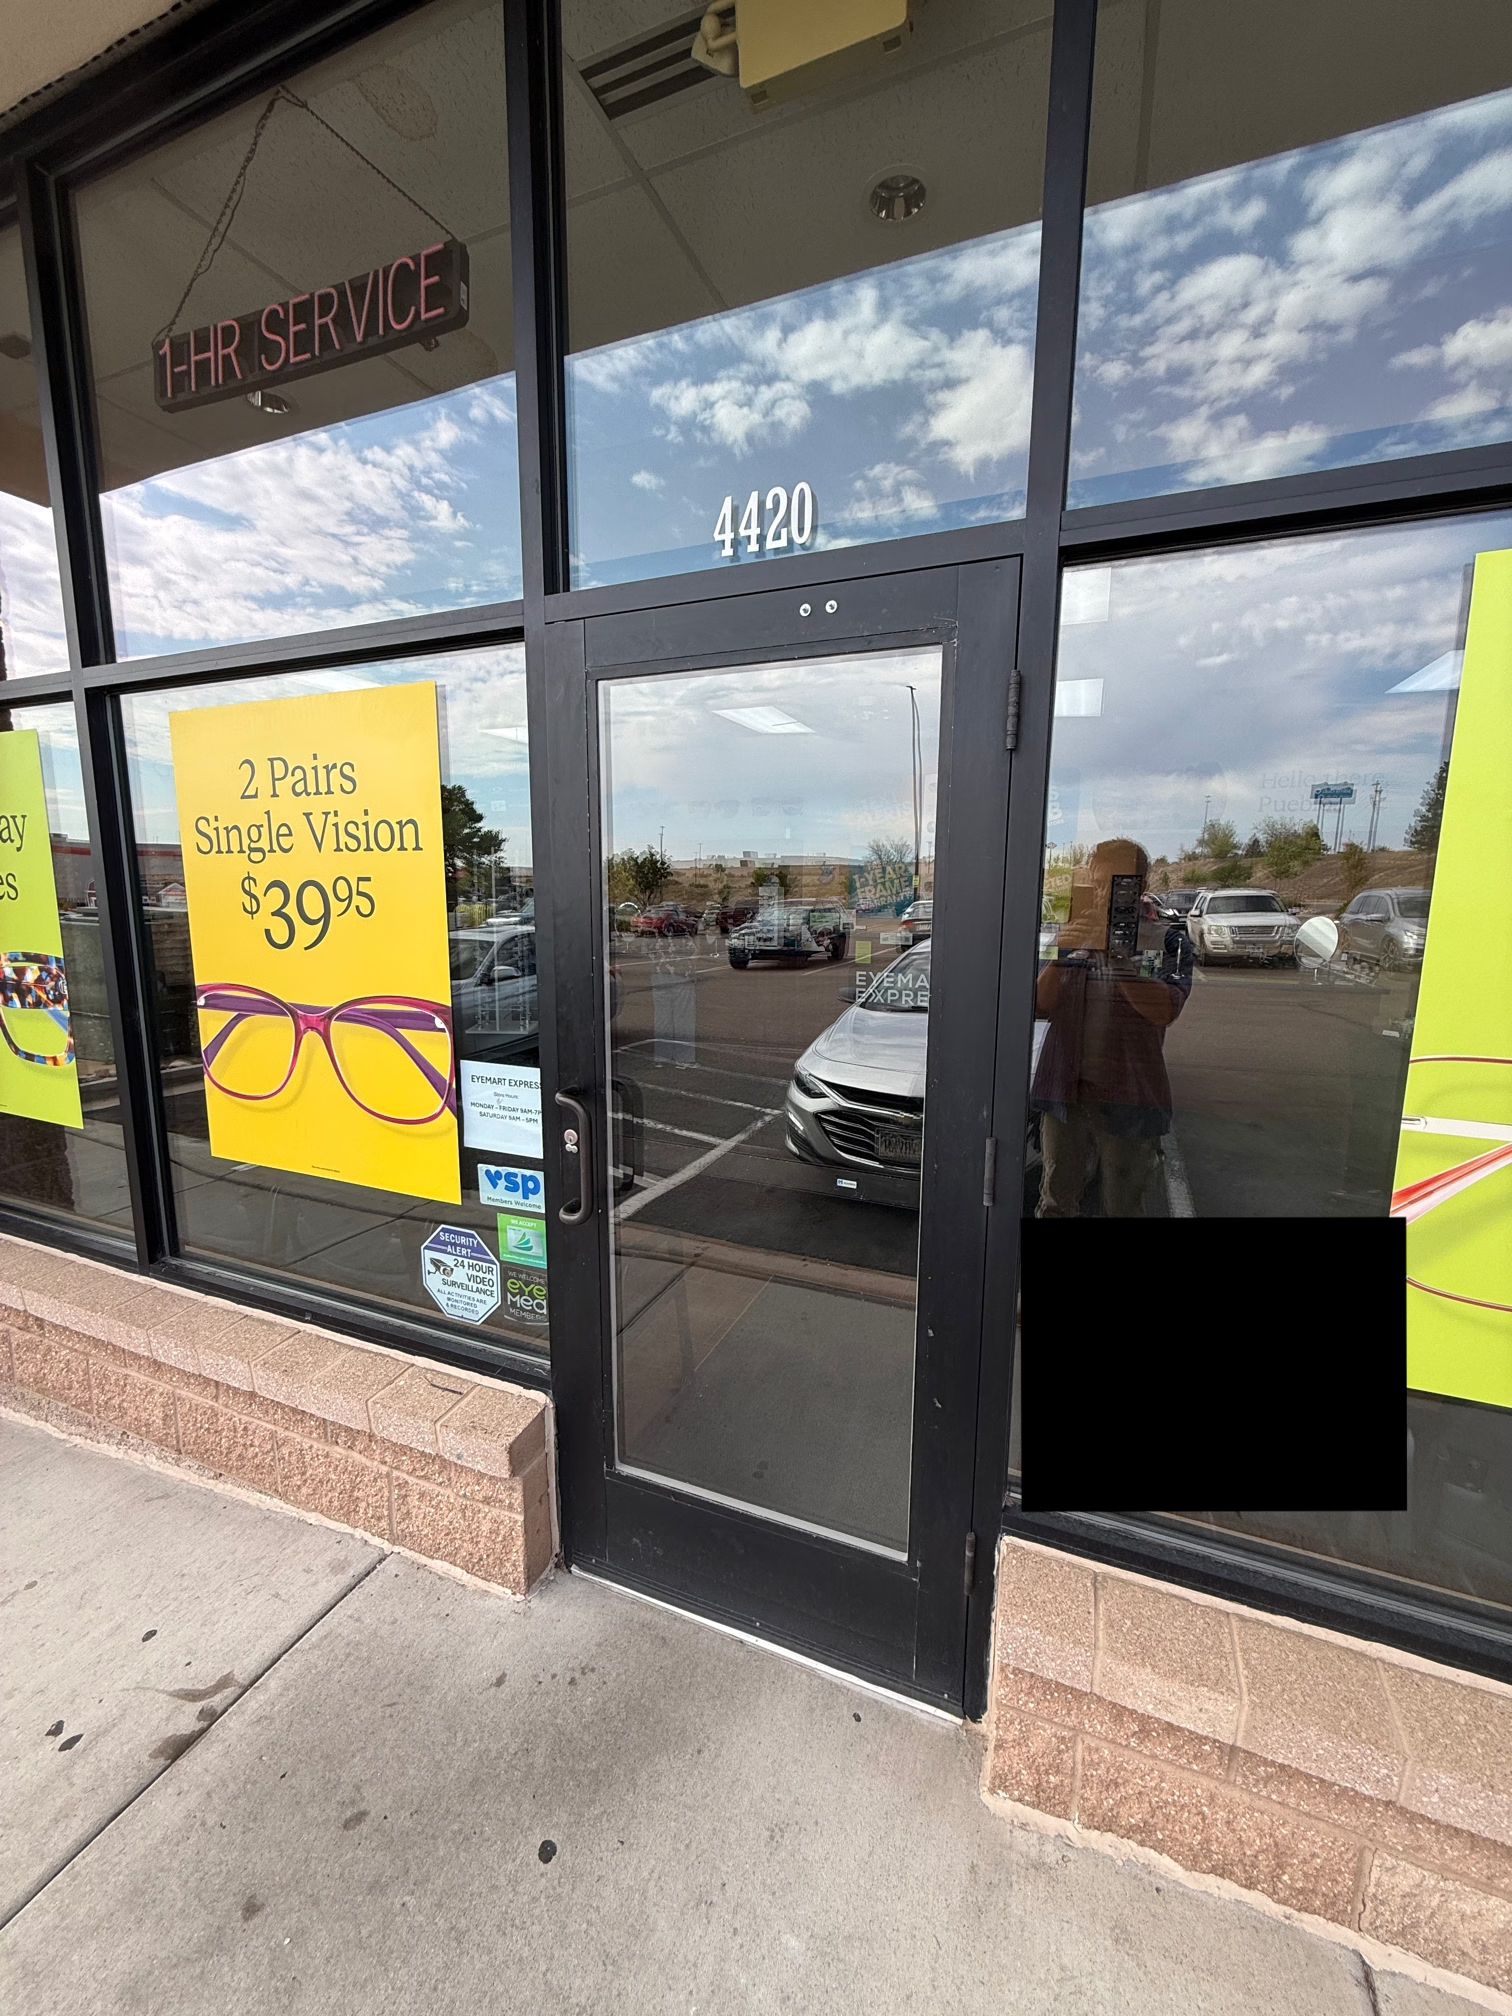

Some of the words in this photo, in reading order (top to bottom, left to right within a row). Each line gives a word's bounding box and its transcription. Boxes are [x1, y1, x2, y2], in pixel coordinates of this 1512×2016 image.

[159, 319, 243, 398] 1-HR
[260, 243, 446, 372] SERVICE
[713, 481, 813, 557] 4420
[238, 758, 260, 800] 2
[267, 753, 358, 799] Pairs
[194, 809, 295, 864] Single
[302, 808, 424, 854] Vision
[855, 971, 929, 989] EYEMA
[855, 988, 929, 1006] EXPRE
[471, 1074, 507, 1087] EYEMART
[470, 1101, 495, 1111] MONDAY
[499, 1104, 519, 1114] FRIDAY
[520, 1107, 542, 1116] 9AM-7P
[479, 1110, 508, 1121] SATURDAY
[484, 1169, 541, 1200] vsp
[486, 1195, 513, 1206] Members
[514, 1199, 542, 1210] Welcome
[439, 1231, 479, 1249] SECURITY
[446, 1244, 472, 1258] ALERT
[453, 1258, 466, 1269] 24
[467, 1261, 495, 1277] HOUR
[441, 1277, 496, 1298] SURVEILLANCE
[466, 1273, 495, 1288] VIDEO
[437, 1287, 446, 1295] ALL
[447, 1290, 476, 1302] ACTIVITIES
[446, 1296, 478, 1309] MONITORED
[450, 1303, 480, 1316] RECORDED
